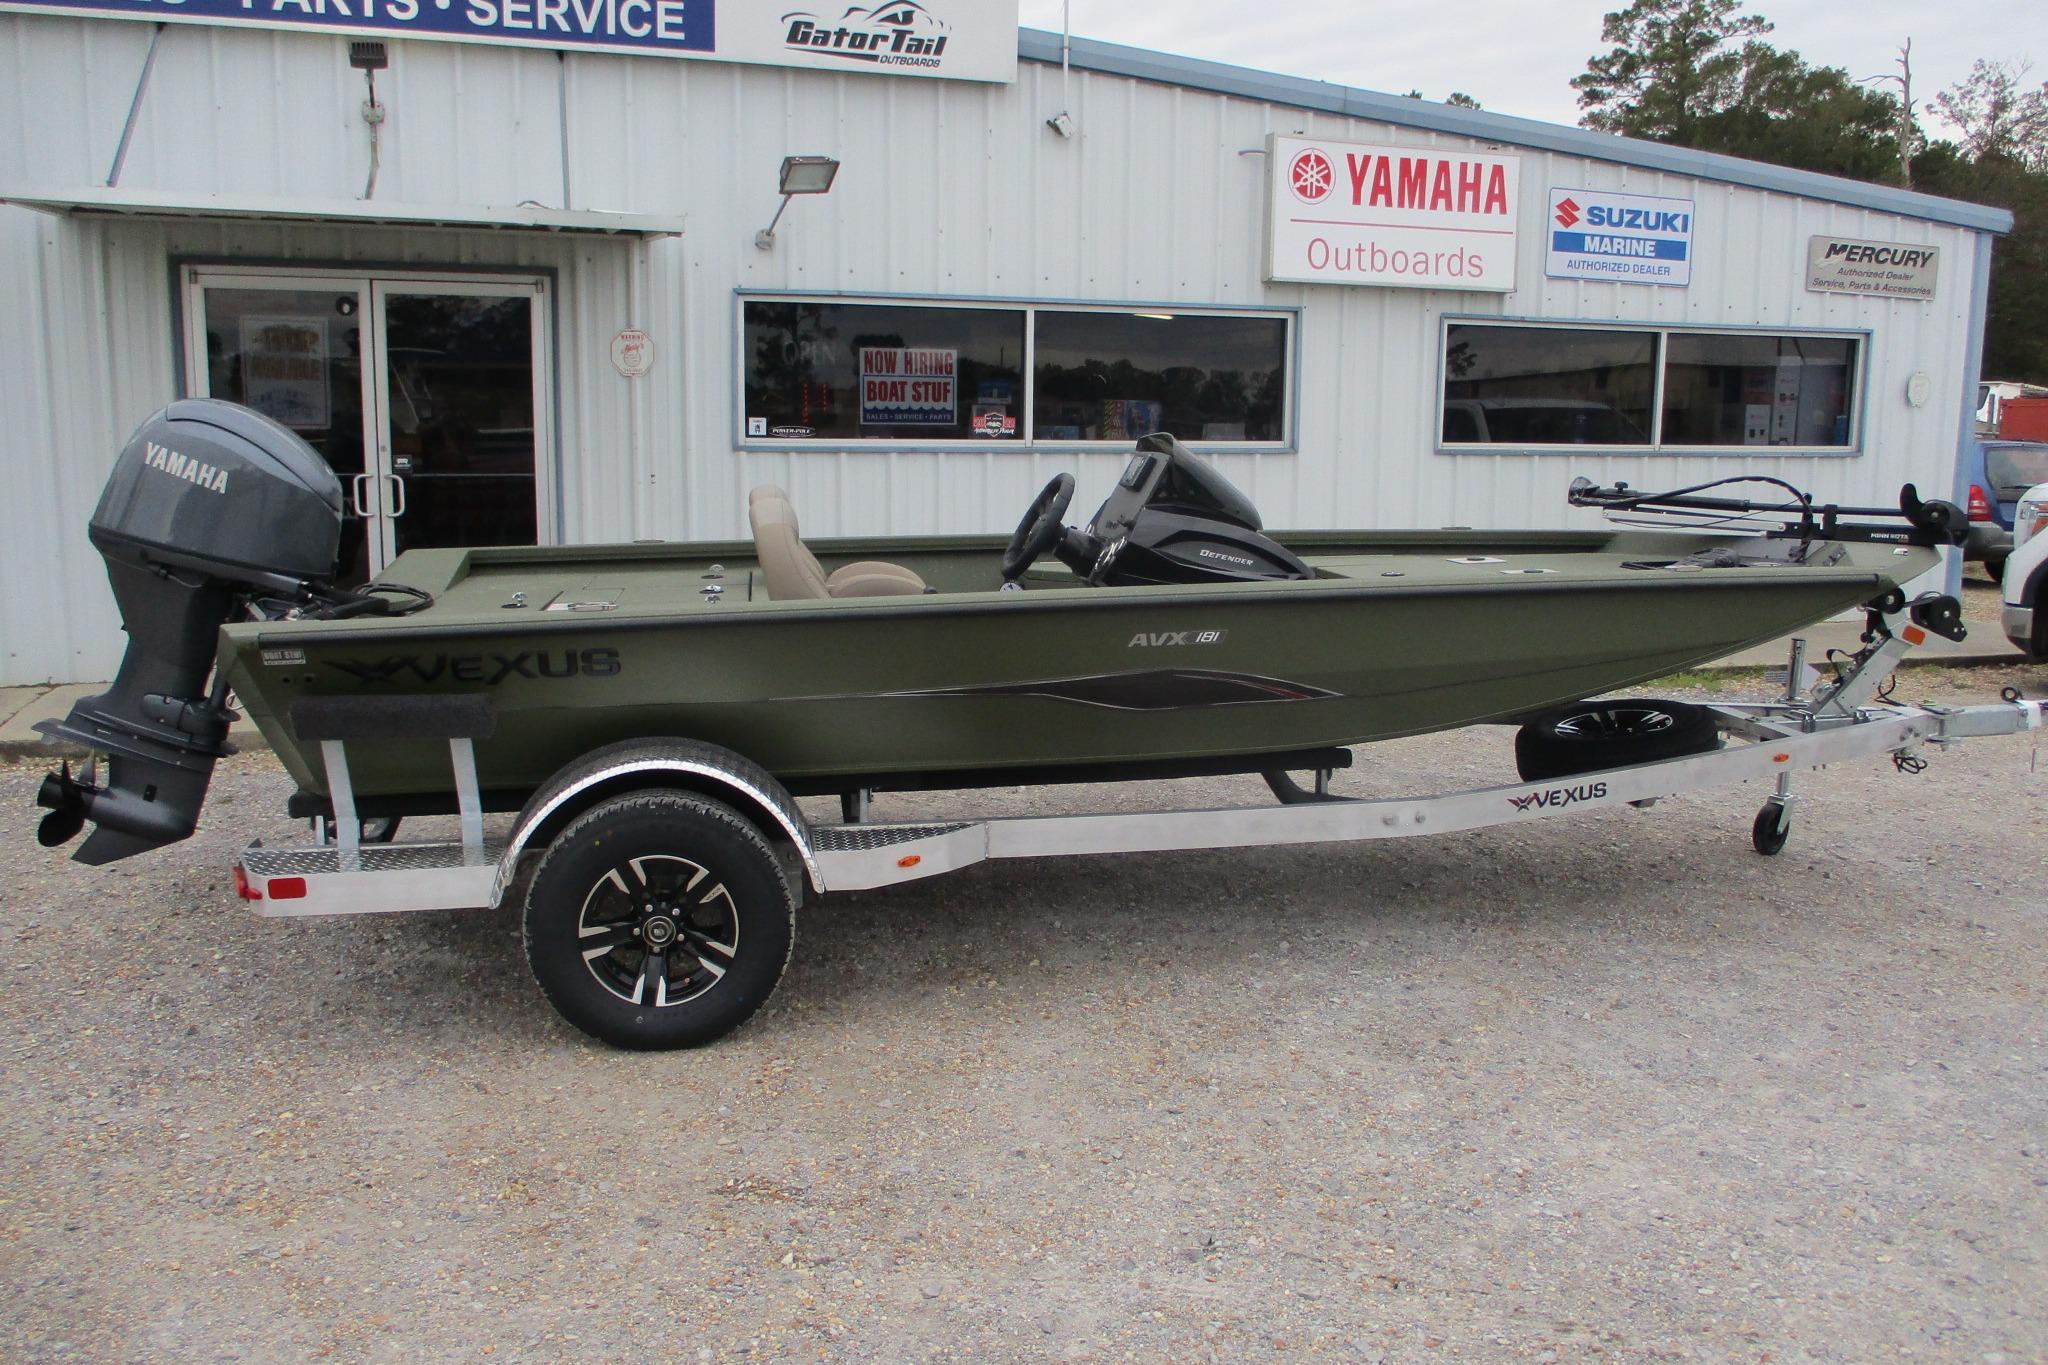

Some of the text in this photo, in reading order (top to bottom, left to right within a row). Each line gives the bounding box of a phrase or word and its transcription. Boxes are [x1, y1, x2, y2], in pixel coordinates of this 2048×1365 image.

[466, 0, 686, 41] SERVICE
[786, 20, 948, 57] GatorTail
[879, 55, 941, 68] OUTBOARDS
[1346, 153, 1508, 215] YAMAHA
[1586, 205, 1689, 233] SUZUKI
[1307, 237, 1484, 278] Outboards
[1583, 235, 1656, 257] MARINE
[1824, 243, 1935, 268] MERCURY
[1567, 260, 1671, 276] AUTHORIZED DEALER
[1837, 267, 1914, 281] Authorized Dealer
[1812, 277, 1846, 289] Service,
[1848, 280, 1871, 290] Parts
[1881, 283, 1931, 296] Accessories
[863, 350, 954, 376] NOW HIRING
[866, 380, 951, 404] BOAT STUF
[144, 441, 229, 494] YAMAHA
[1199, 549, 1254, 566] DEFENDER
[1128, 631, 1220, 648] AVX 181
[408, 648, 622, 686] VEXUS
[1534, 782, 1607, 809] VEXUS
